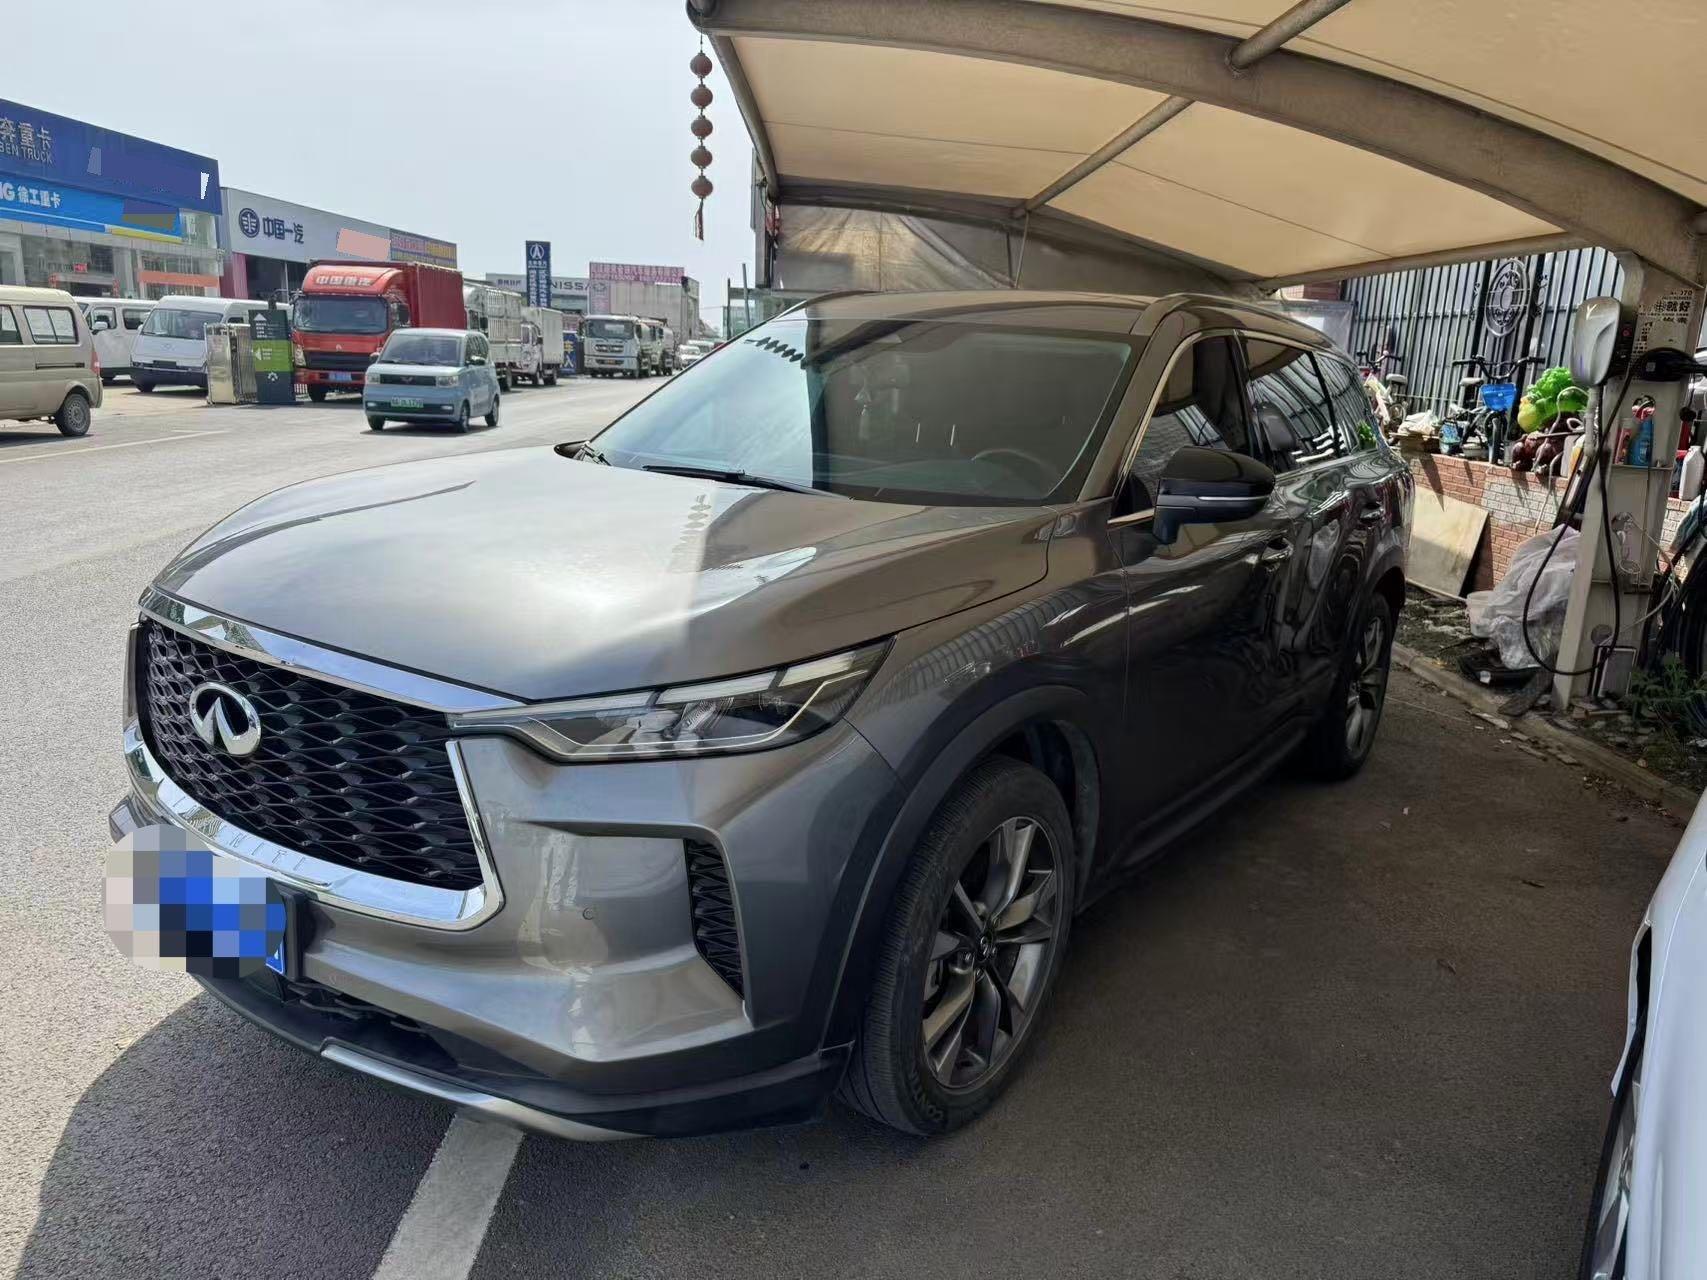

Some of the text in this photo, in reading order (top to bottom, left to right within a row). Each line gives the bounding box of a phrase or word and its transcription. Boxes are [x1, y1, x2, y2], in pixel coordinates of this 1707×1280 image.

[20, 145, 53, 165] TRUCK
[17, 185, 61, 208] 徐工重卡
[262, 216, 304, 244] 中国一汽
